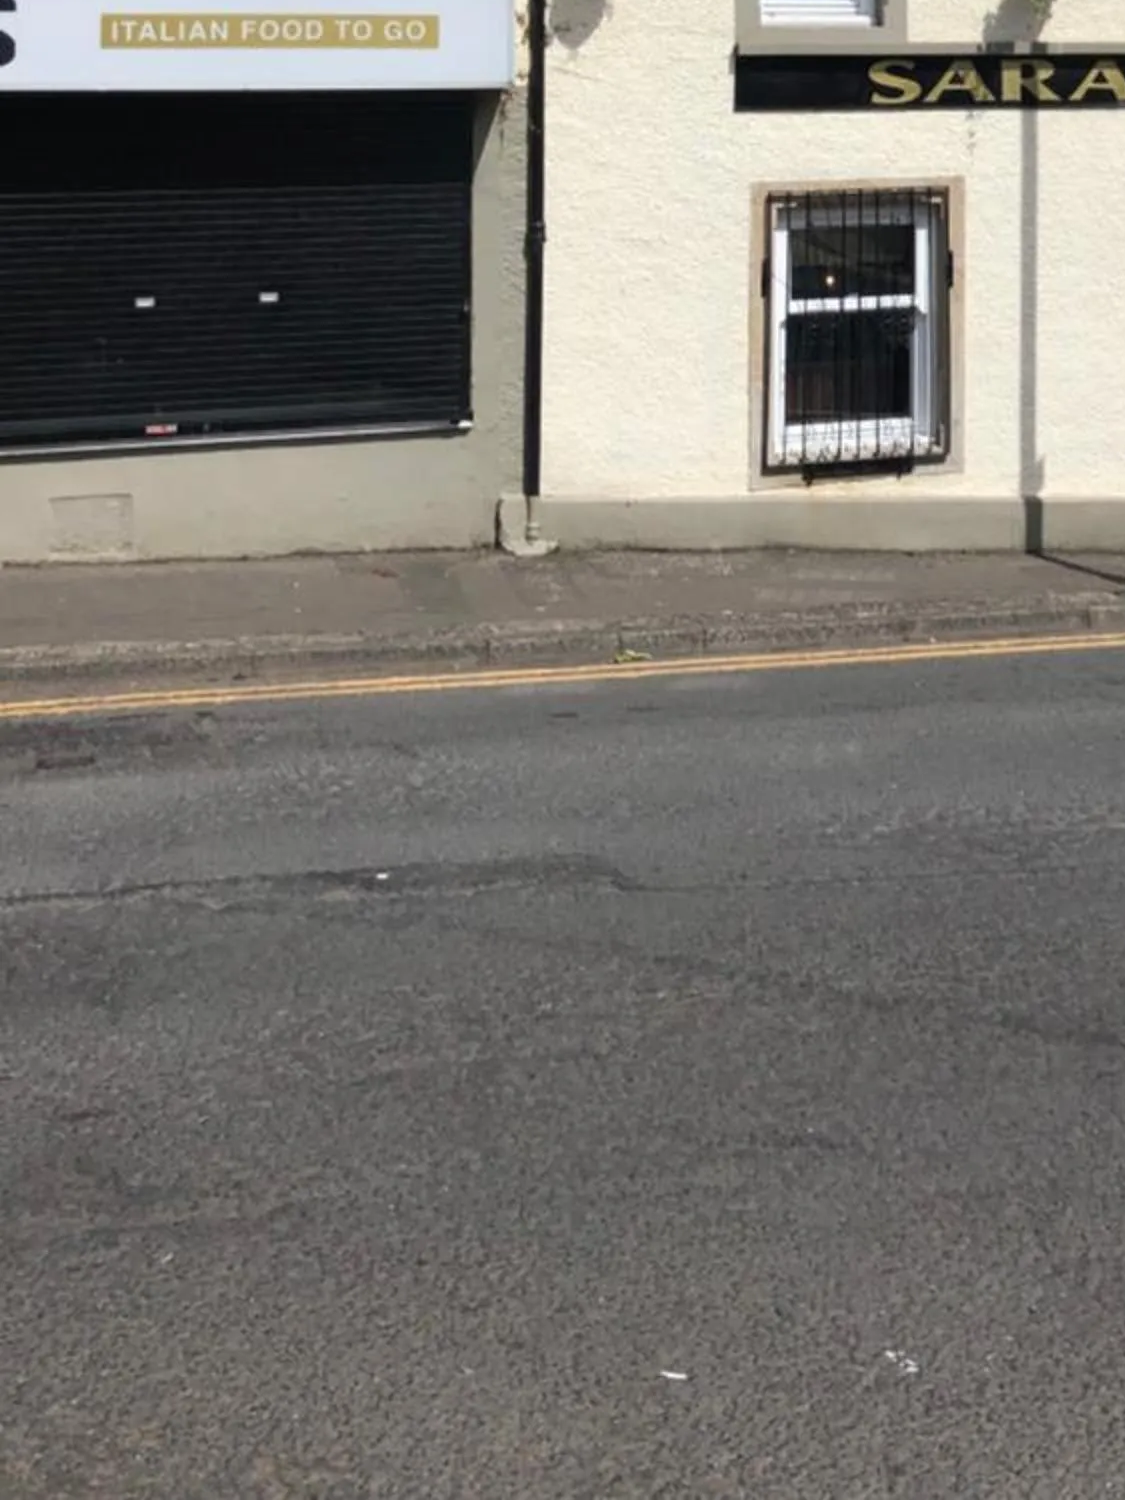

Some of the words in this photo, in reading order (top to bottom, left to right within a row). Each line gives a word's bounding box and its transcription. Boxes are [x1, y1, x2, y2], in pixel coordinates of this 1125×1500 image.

[110, 19, 229, 42] ITALIAN
[240, 19, 324, 42] FOOD
[334, 19, 373, 41] TO
[383, 19, 427, 41] GO
